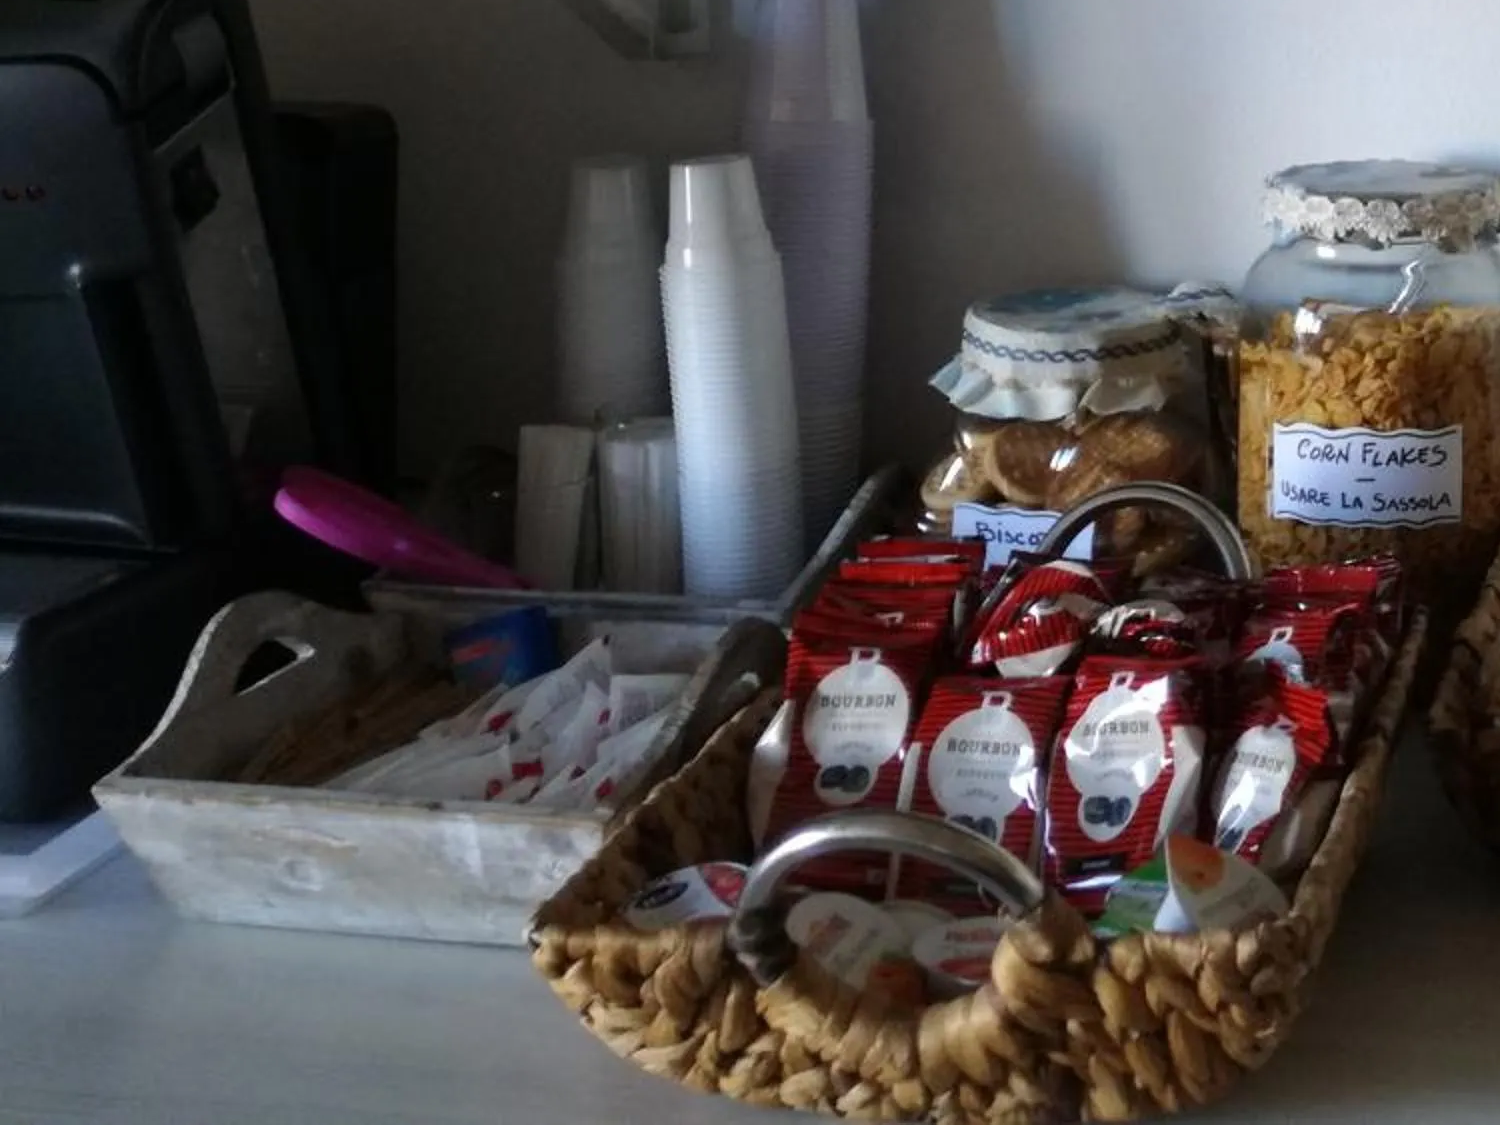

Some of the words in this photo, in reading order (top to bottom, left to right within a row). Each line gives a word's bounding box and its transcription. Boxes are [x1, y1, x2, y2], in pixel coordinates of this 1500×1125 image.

[1296, 438, 1351, 463] CORN
[1361, 442, 1448, 468] FLAKES
[1280, 478, 1332, 507] USARE
[1340, 492, 1364, 510] LA
[1371, 492, 1452, 513] SASSOLA
[819, 692, 898, 709] BOURBON
[946, 736, 1023, 756] BOURBON
